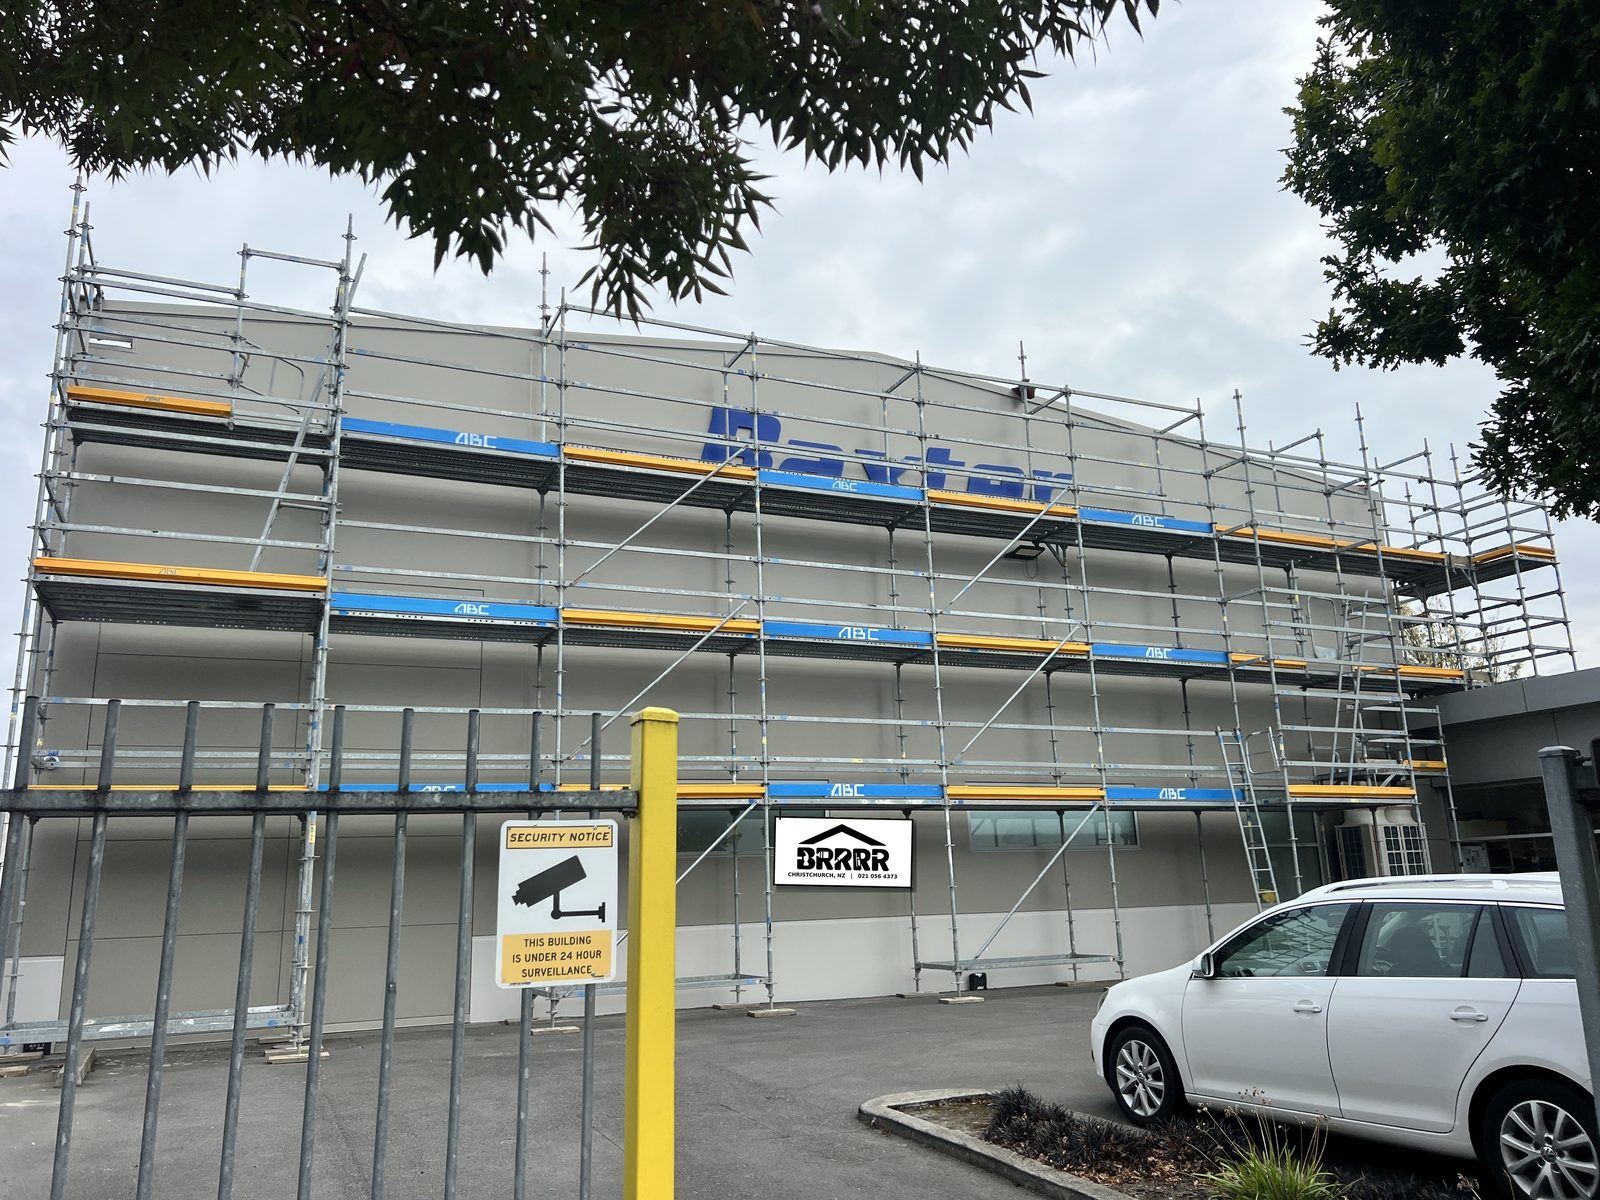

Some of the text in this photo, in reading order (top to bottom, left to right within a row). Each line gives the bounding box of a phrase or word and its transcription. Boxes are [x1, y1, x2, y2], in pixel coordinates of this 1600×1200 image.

[455, 432, 497, 448] ABC
[832, 480, 858, 492] ABC
[1131, 514, 1165, 528] ABC
[454, 603, 490, 616] ABC
[838, 626, 880, 641] ABC
[1145, 647, 1172, 659] ABC
[831, 783, 865, 797] ABC
[1159, 788, 1186, 800] ABC
[510, 832, 610, 843] SECURITY NOTICE
[796, 847, 890, 871] BRRRR
[787, 871, 836, 879] CHRISTCHURCH,
[524, 936, 592, 947] THIS BUILDING
[512, 950, 602, 963] IS UNDER 24 HOUR
[521, 965, 593, 978] SURVEILLANCE
